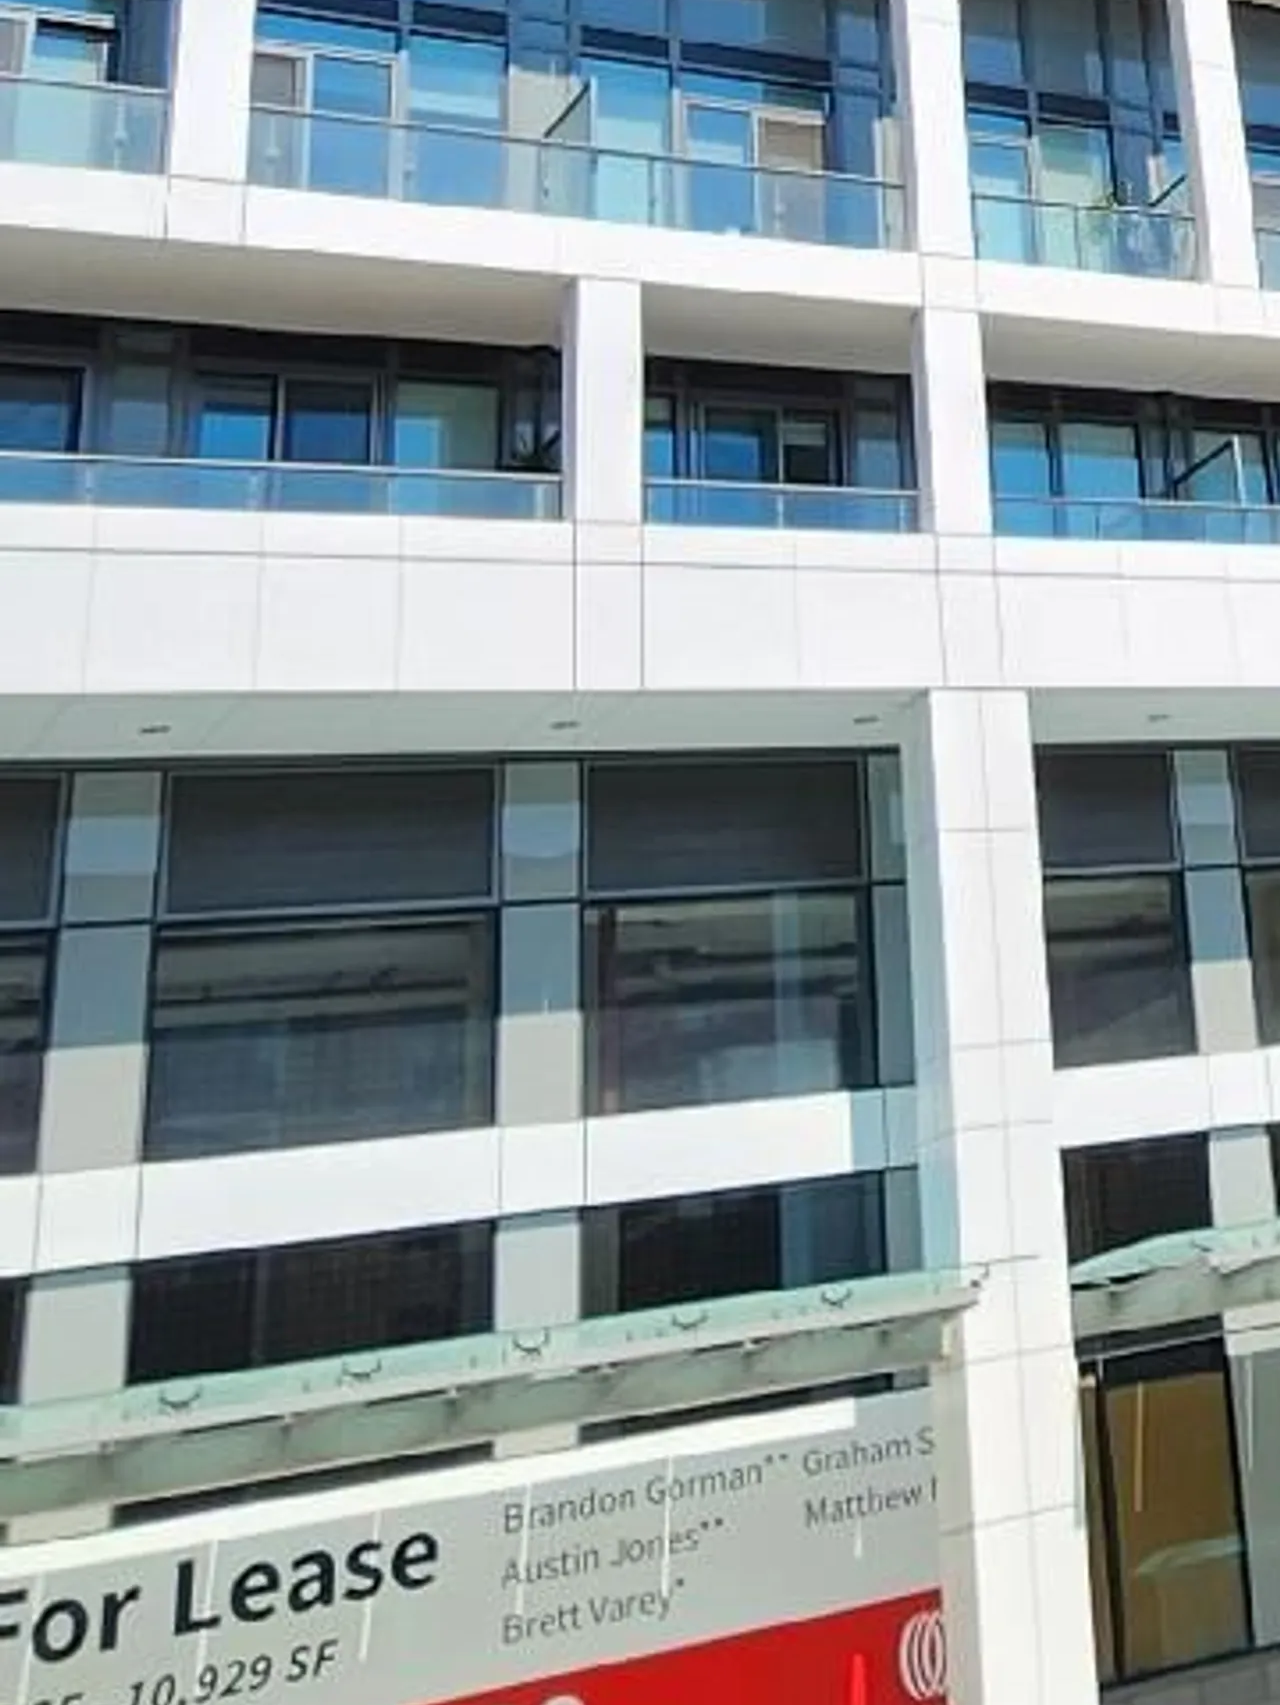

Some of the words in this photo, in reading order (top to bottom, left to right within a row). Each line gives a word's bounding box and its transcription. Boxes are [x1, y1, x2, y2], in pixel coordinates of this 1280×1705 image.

[801, 1436, 914, 1477] Graham
[503, 1486, 635, 1534] Brandon
[804, 1485, 922, 1528] Matthew
[173, 1530, 439, 1637] Lease
[501, 1545, 600, 1589] Austin
[502, 1596, 583, 1646] Brett
[285, 1638, 339, 1683] SF
